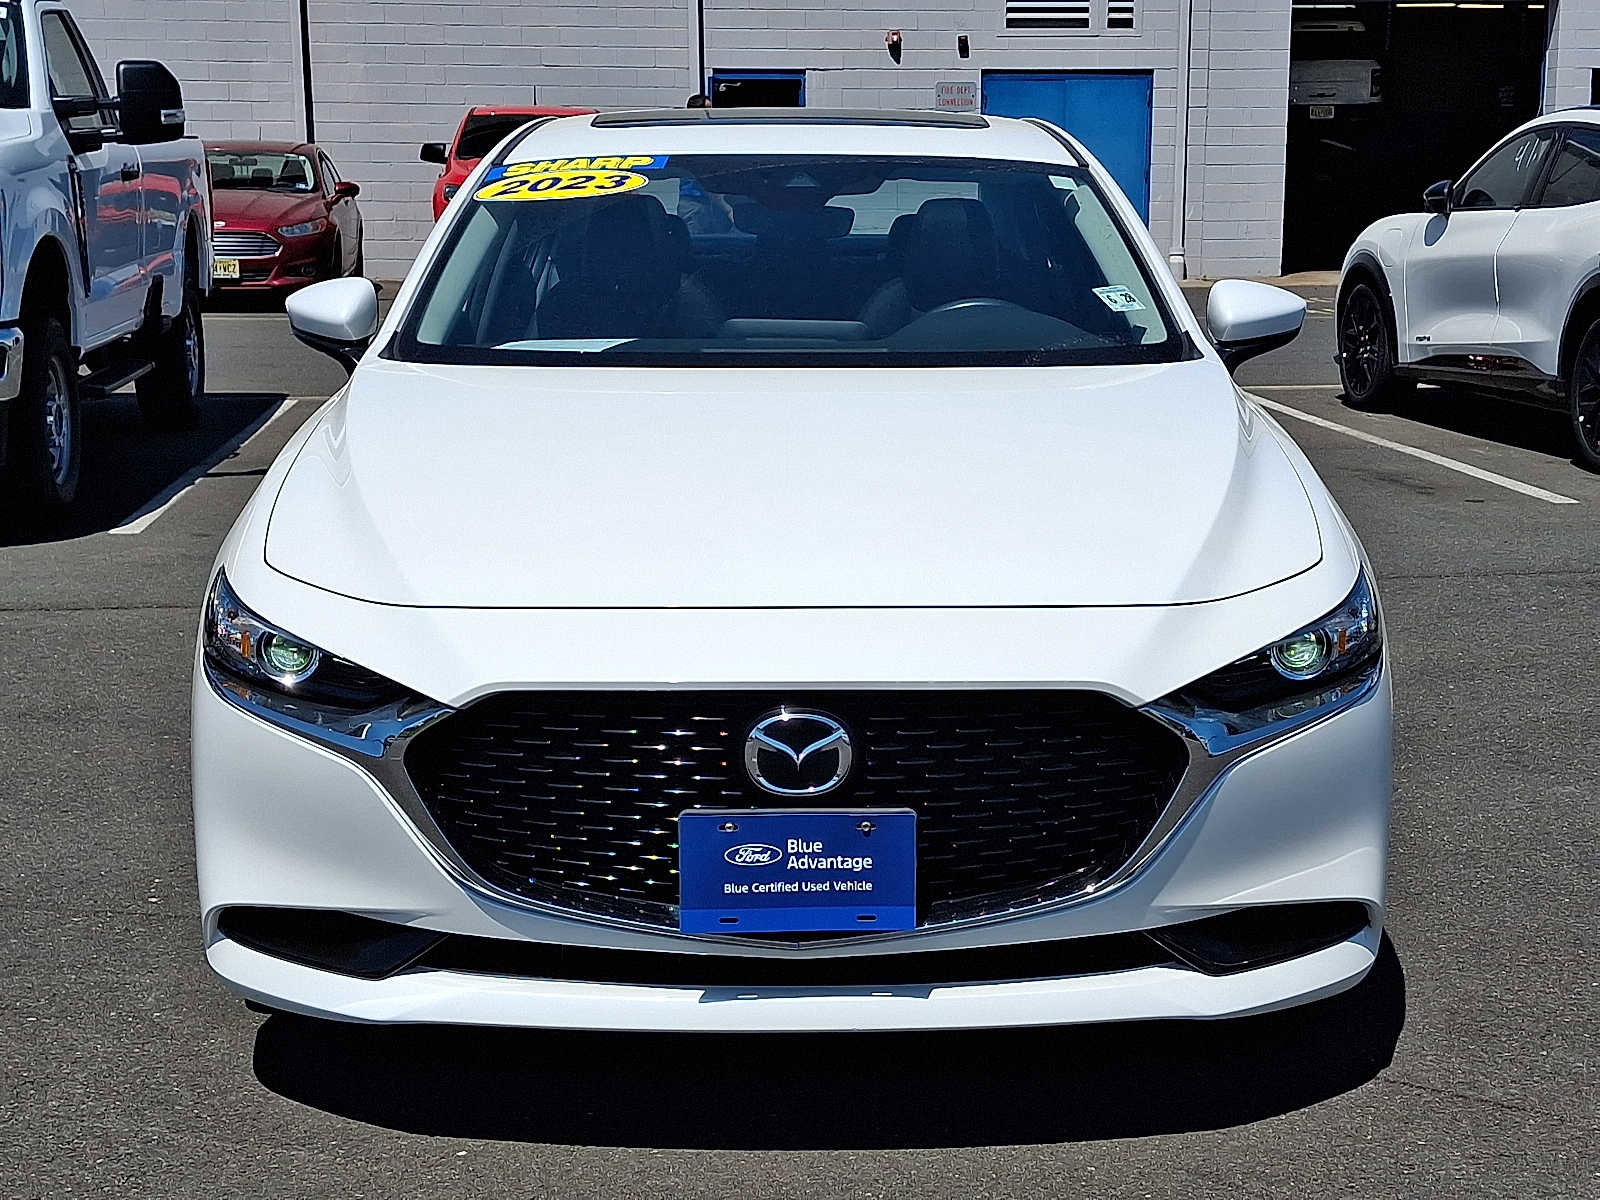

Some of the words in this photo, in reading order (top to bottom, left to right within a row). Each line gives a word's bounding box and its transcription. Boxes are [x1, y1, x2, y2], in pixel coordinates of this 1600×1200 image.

[503, 156, 653, 177] SHARP
[490, 175, 632, 198] 2023
[734, 846, 772, 863] Ford
[787, 839, 823, 854] Blue
[787, 855, 873, 872] Advantage
[724, 883, 749, 894] Blue
[752, 881, 799, 893] Certified
[802, 881, 830, 892] Used
[833, 880, 873, 892] Vehicle
